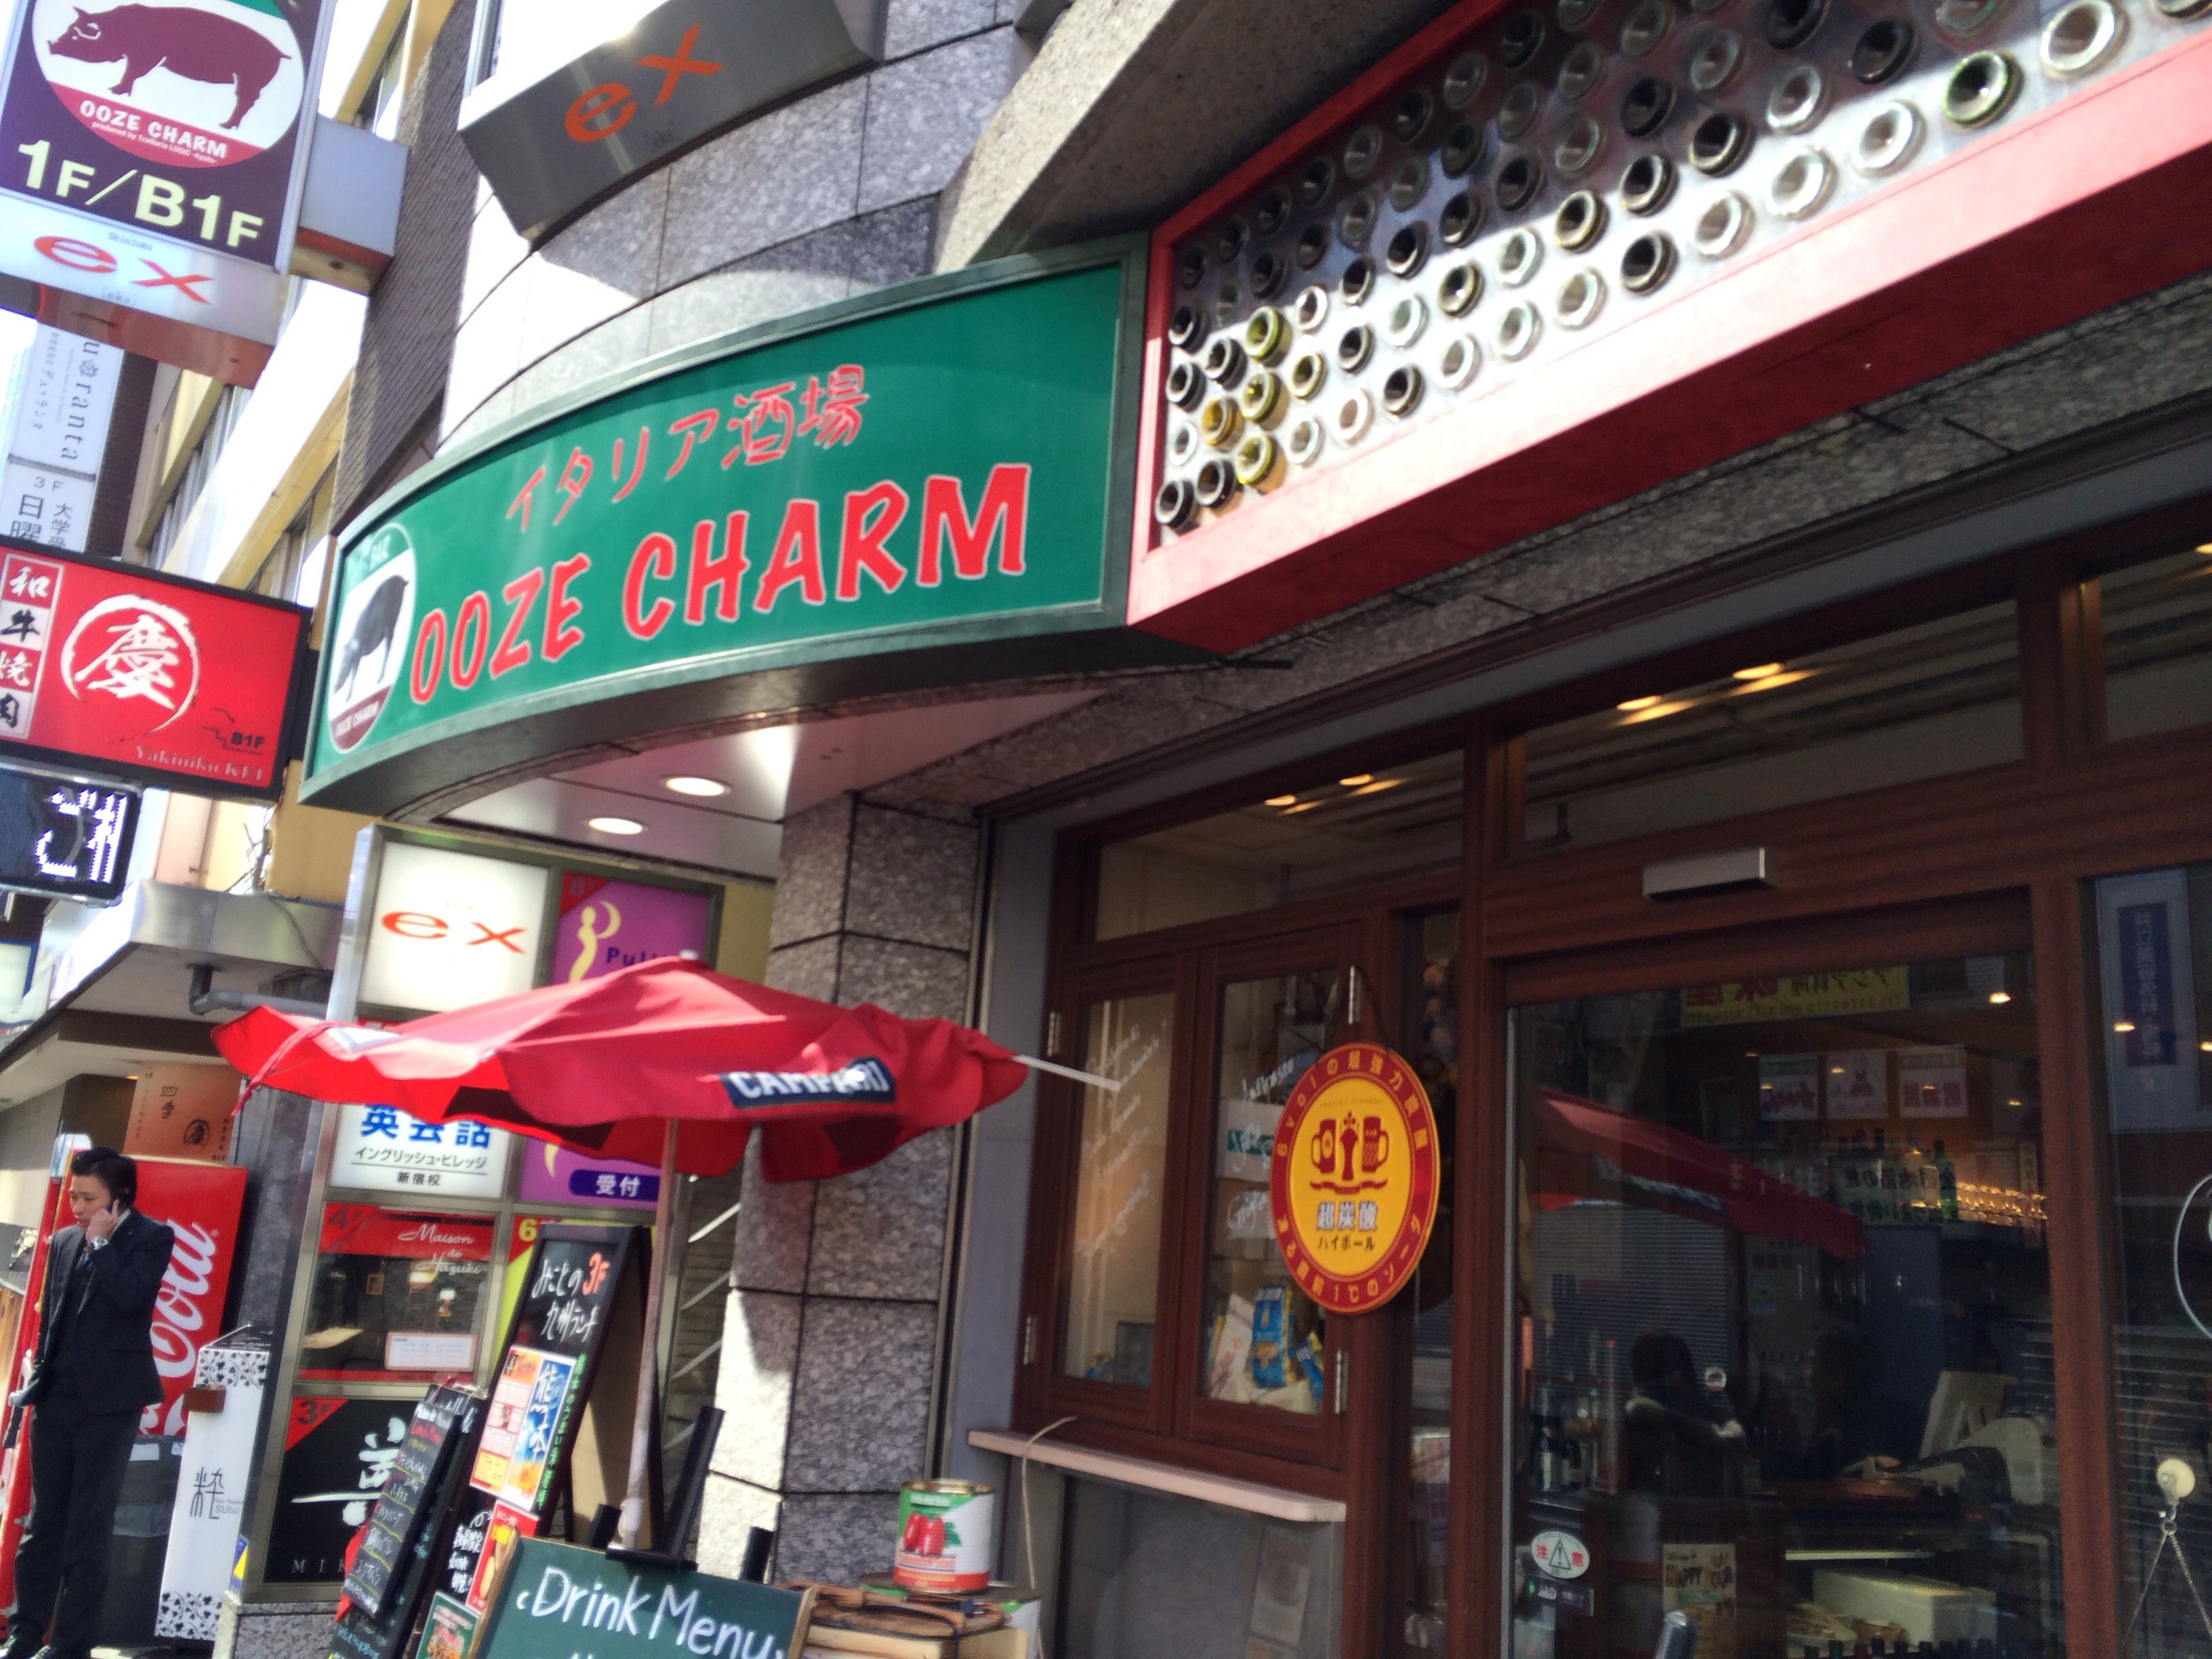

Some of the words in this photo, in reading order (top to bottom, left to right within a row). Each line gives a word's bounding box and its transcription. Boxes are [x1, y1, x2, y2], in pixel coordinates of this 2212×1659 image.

[564, 24, 724, 143] ex
[80, 100, 141, 131] OOZE
[148, 121, 228, 159] CHARM
[33, 235, 214, 304] ex
[506, 364, 870, 533] イタリア酒場
[409, 552, 593, 707] OOZE
[621, 462, 1031, 641] CHARM
[231, 731, 265, 747] B1F
[135, 746, 220, 773] Yakiniku
[381, 911, 528, 954] ex
[396, 1172, 441, 1187] 新宿校
[596, 1174, 641, 1197] 受付
[1316, 1200, 1378, 1232] 超炭酸
[397, 1223, 474, 1244] Maison
[1317, 1235, 1376, 1252] ハイボール
[447, 1248, 463, 1258] de
[297, 1400, 329, 1425] 3F
[531, 1564, 652, 1637] Drink
[648, 1583, 778, 1659] Menu
